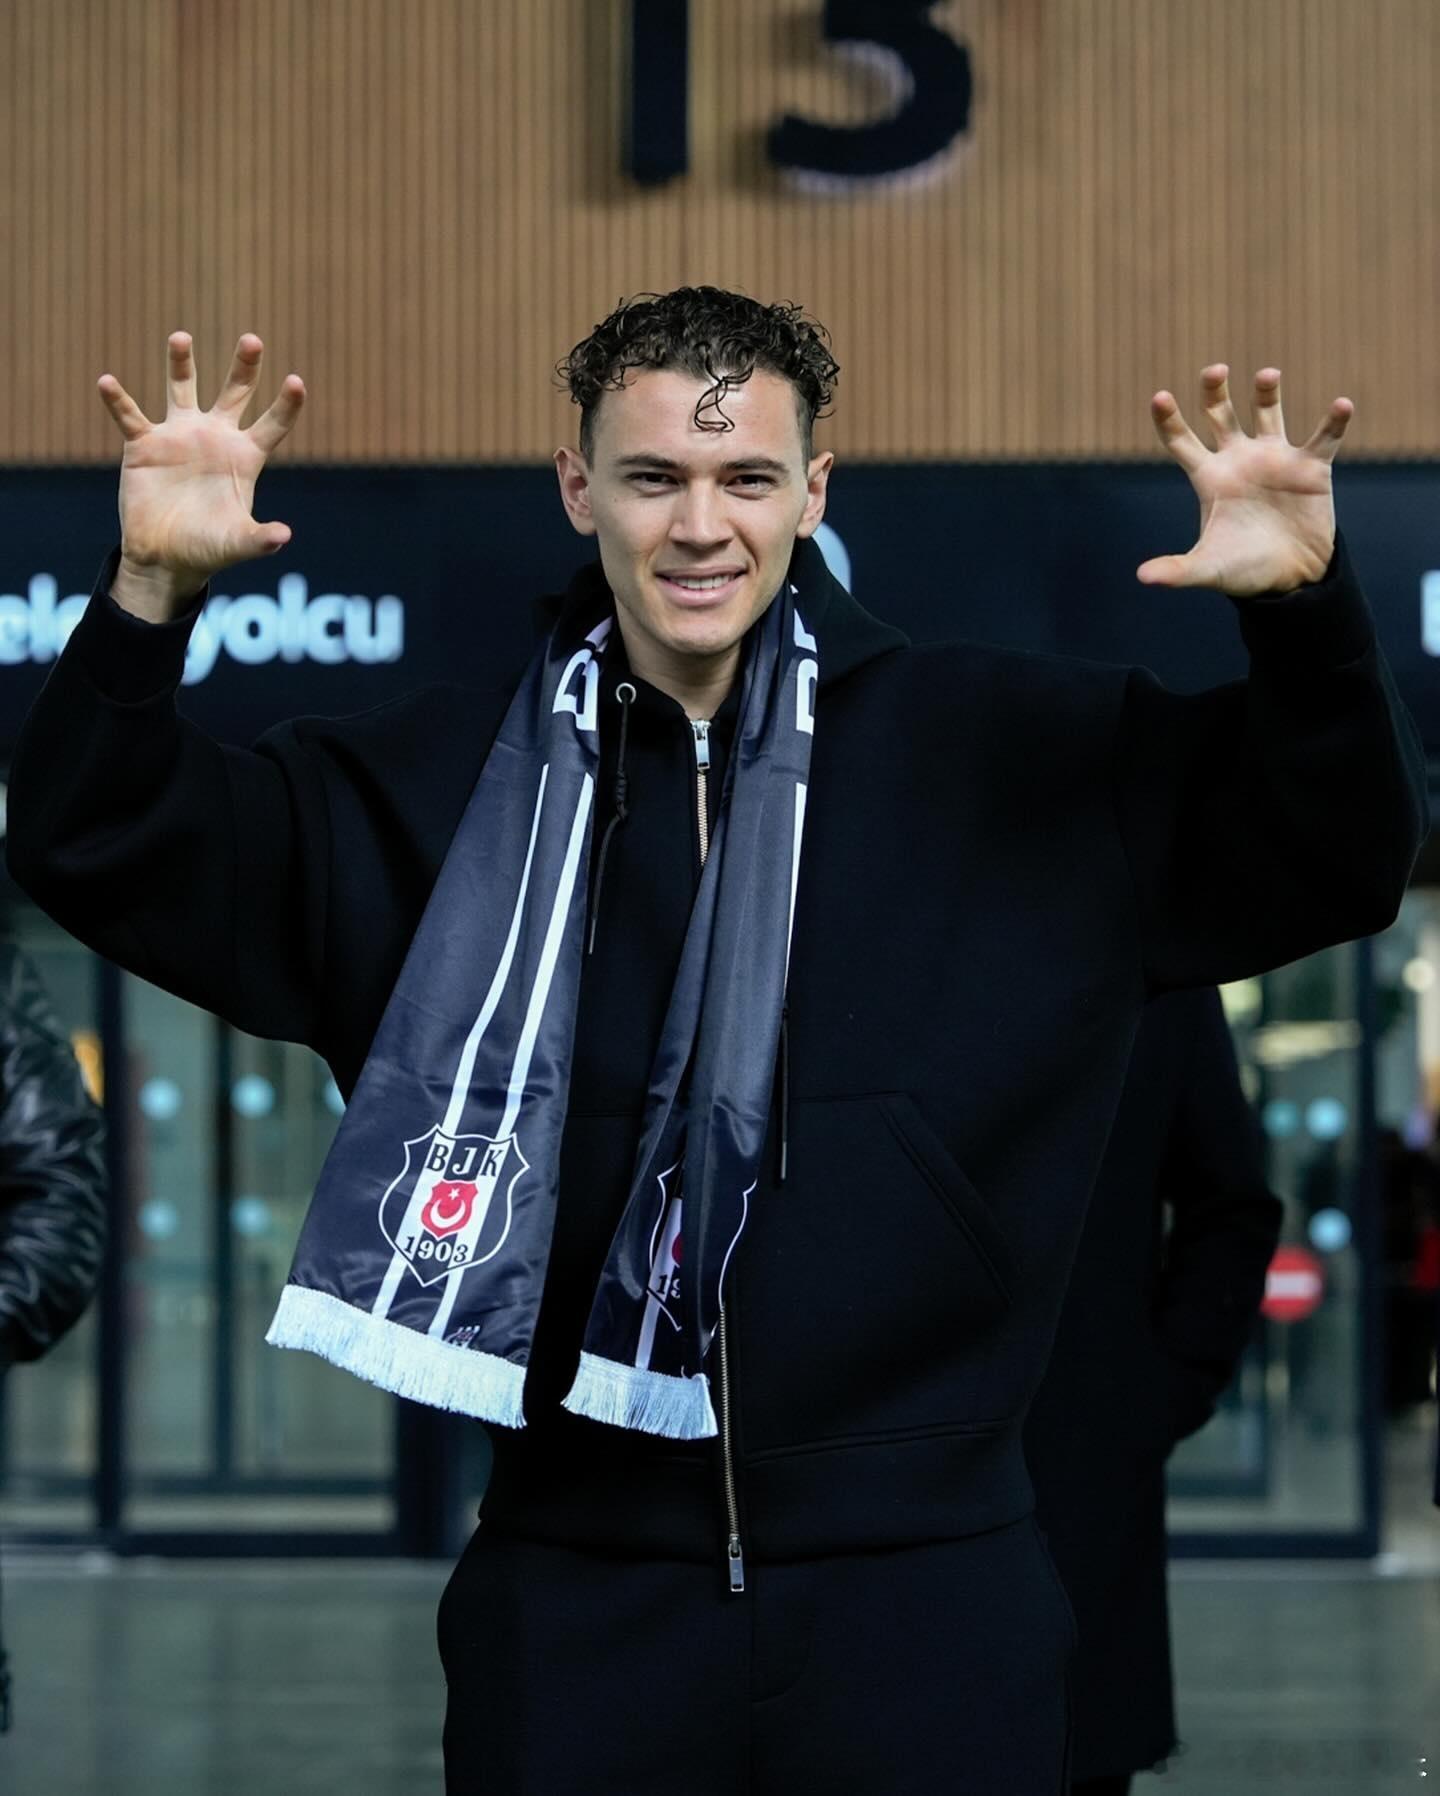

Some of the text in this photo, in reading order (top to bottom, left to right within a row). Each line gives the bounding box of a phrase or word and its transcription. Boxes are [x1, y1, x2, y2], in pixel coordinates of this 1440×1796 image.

[181, 573, 403, 686] yolcu
[427, 1143, 503, 1177] BJK
[403, 1235, 470, 1263] 1903
